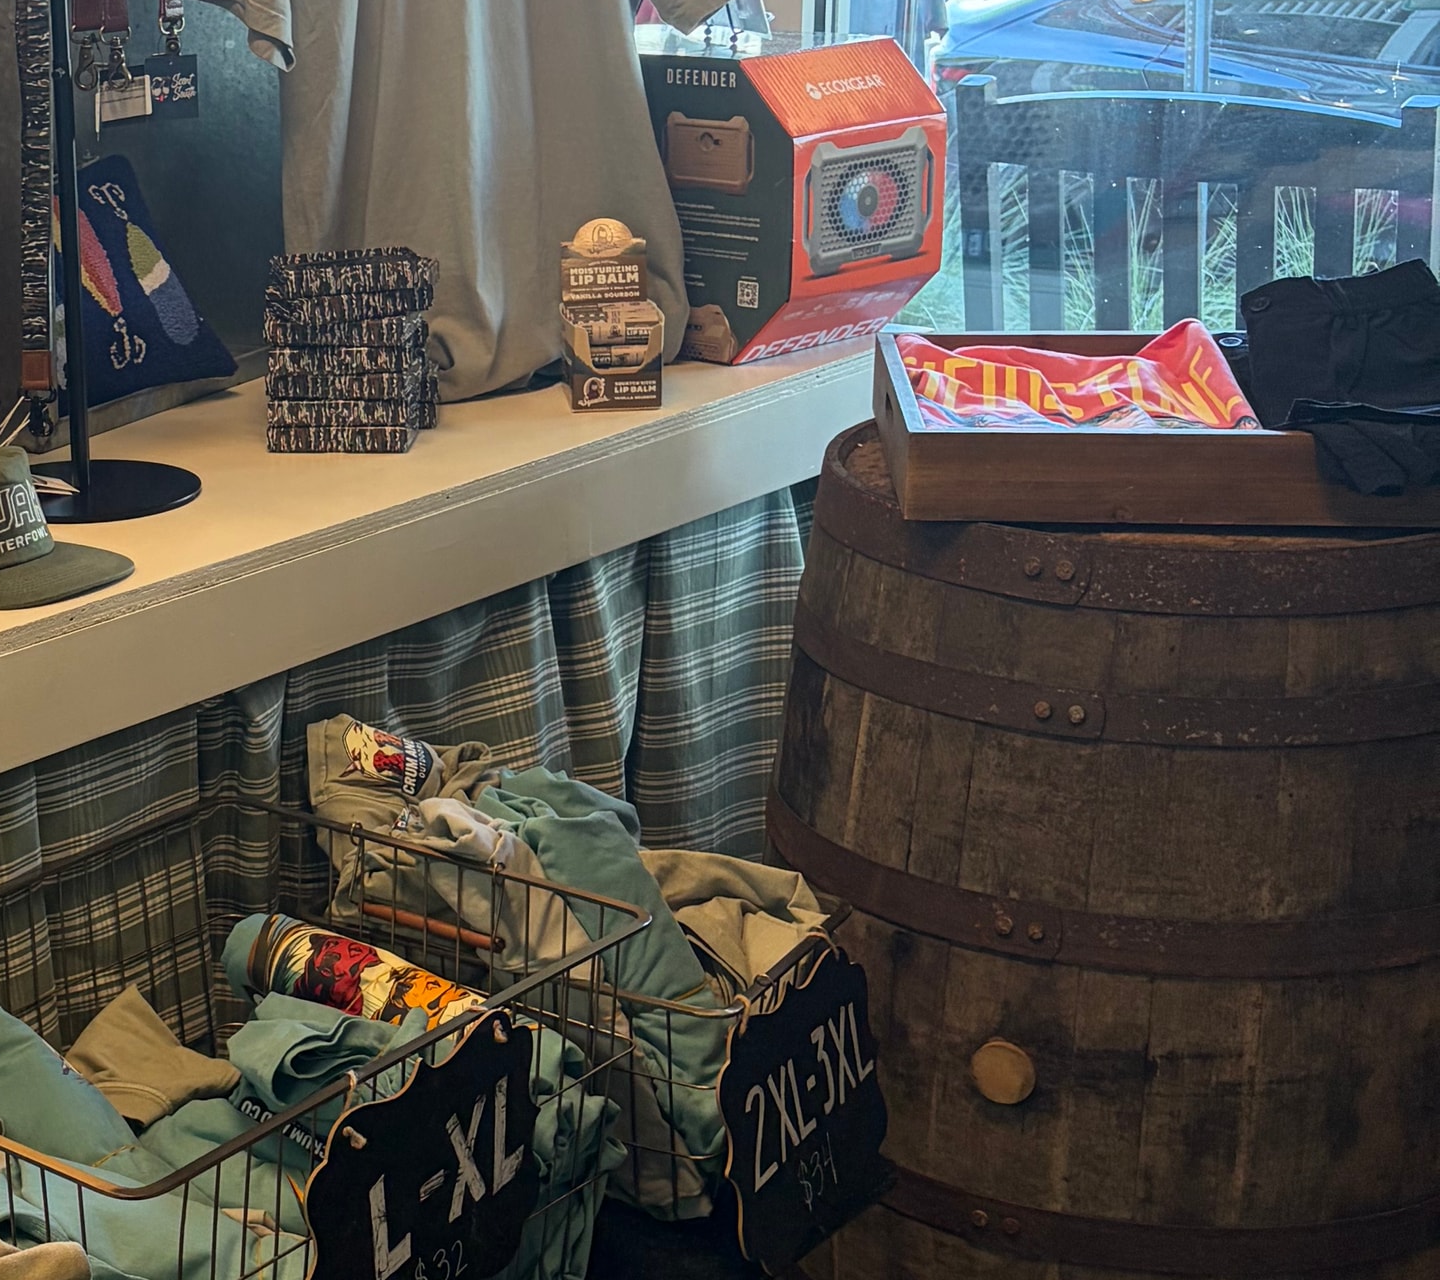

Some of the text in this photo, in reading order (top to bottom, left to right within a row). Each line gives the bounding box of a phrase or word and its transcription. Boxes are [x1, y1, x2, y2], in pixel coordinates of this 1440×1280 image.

[666, 68, 737, 89] DEFENDER
[819, 74, 886, 98] ECOXGEAR
[172, 86, 196, 101] South
[570, 264, 639, 275] MOISTURIZING
[570, 272, 640, 286] LIP BALM
[570, 291, 640, 300] VANILLA BOURBON
[744, 316, 890, 363] DEFENDER
[614, 385, 656, 394] LIP BALM
[403, 758, 419, 795] CRUM
[745, 1002, 874, 1193] 2XL-3XL
[240, 1099, 261, 1118] CO
[797, 1131, 838, 1212] $34
